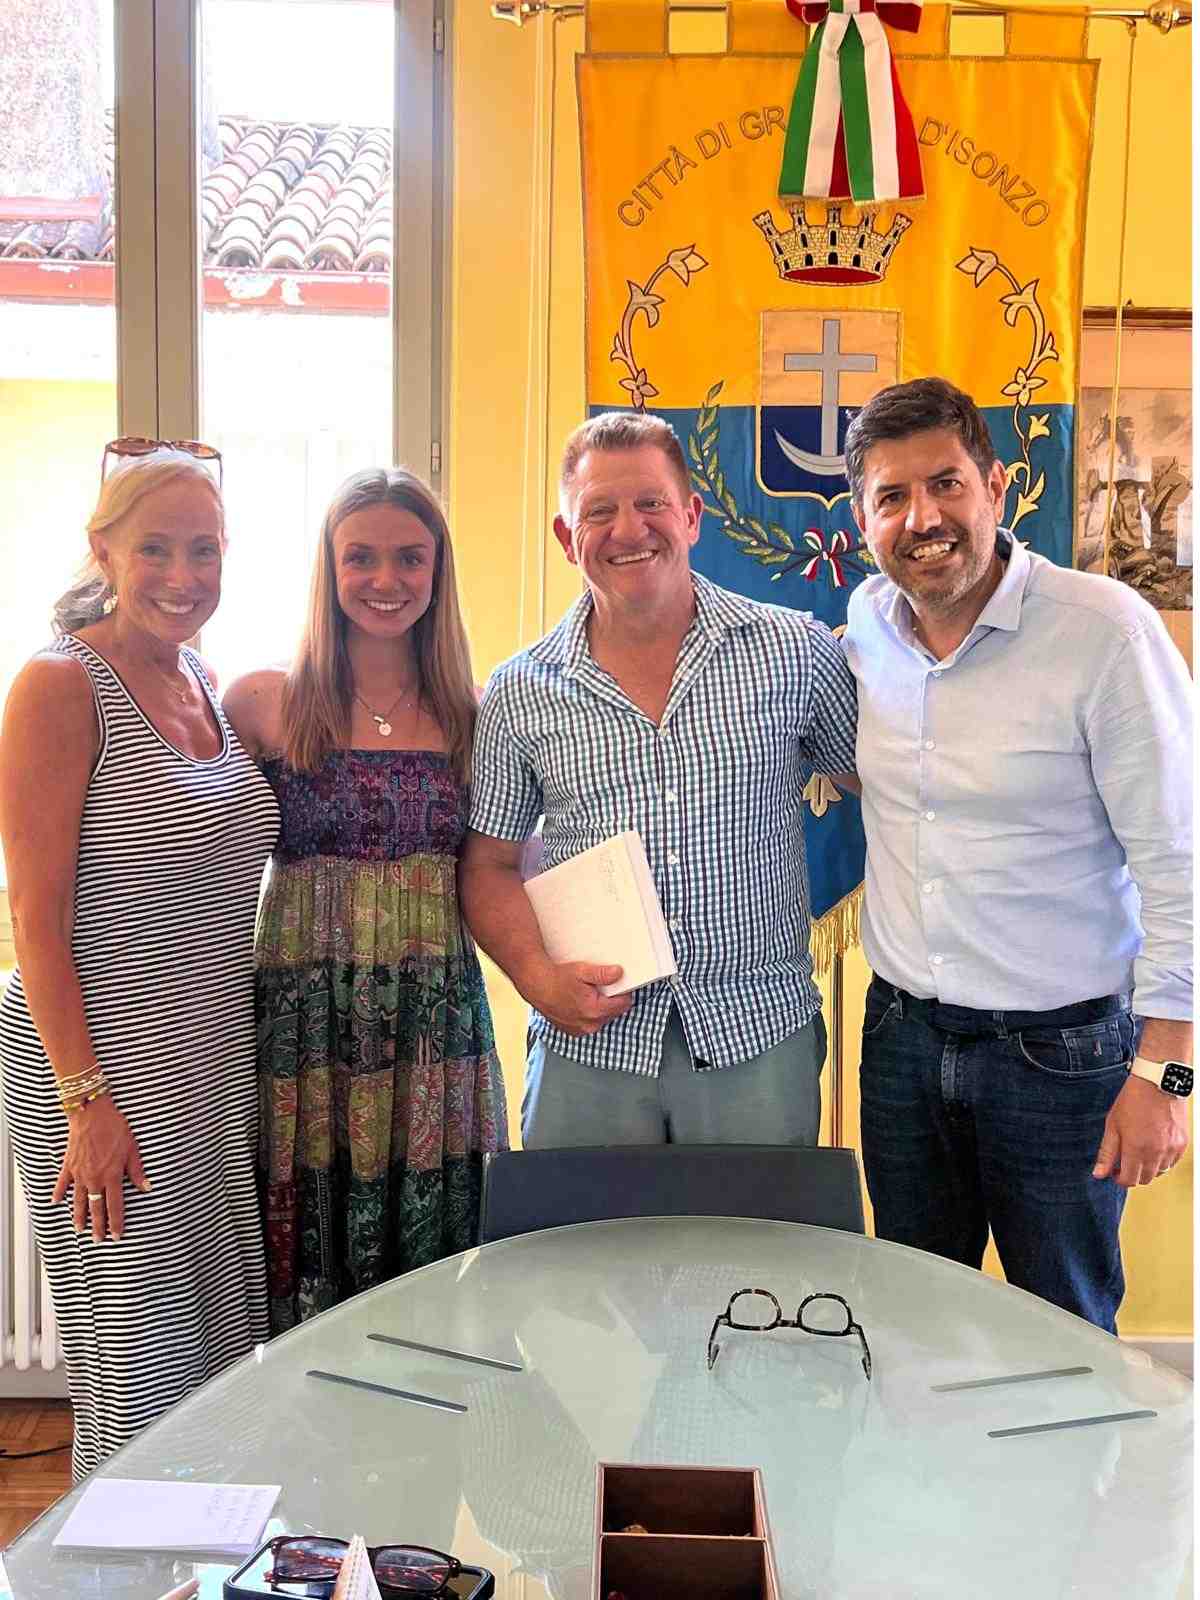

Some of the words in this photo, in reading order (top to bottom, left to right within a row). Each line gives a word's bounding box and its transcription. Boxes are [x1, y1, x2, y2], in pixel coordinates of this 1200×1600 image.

[617, 145, 698, 227] CITTÀ
[694, 121, 732, 160] DI
[918, 116, 1050, 227] D'ISONZO
